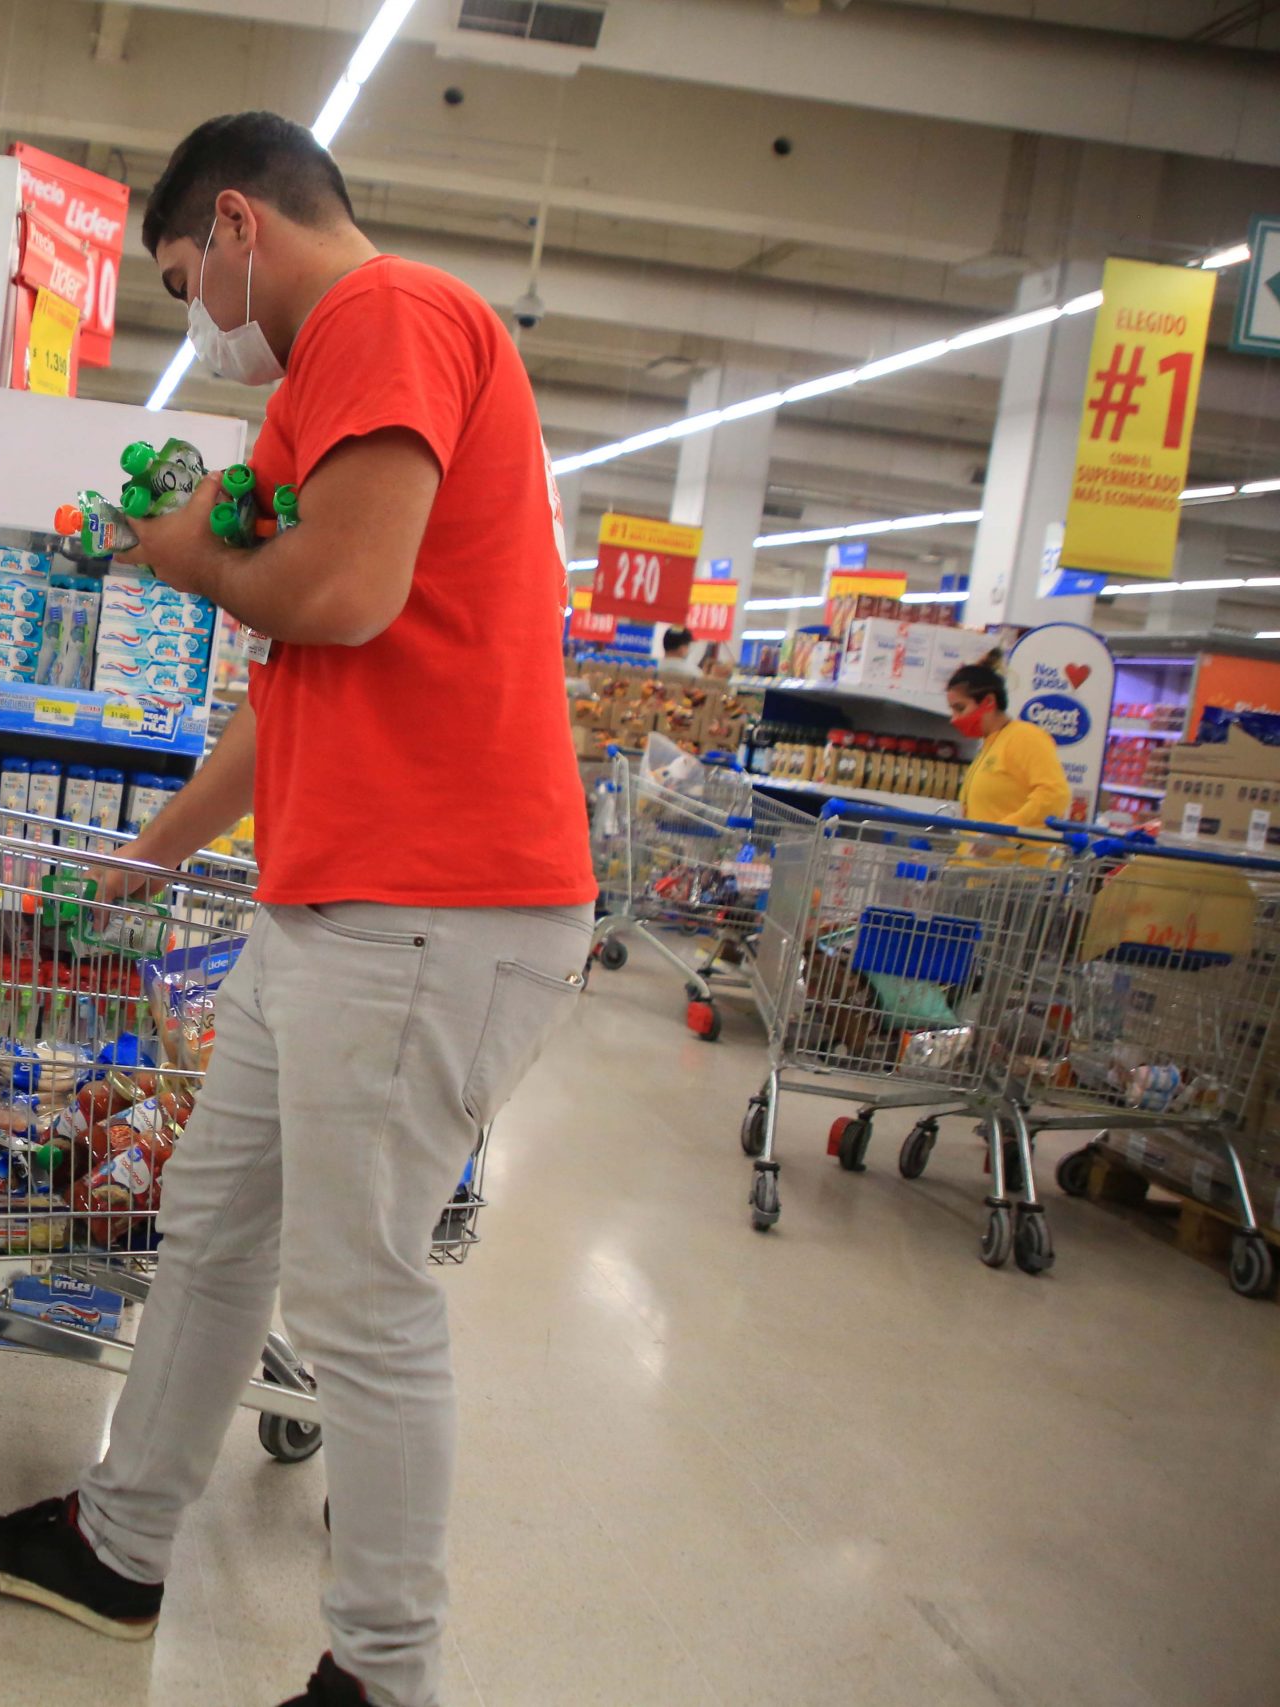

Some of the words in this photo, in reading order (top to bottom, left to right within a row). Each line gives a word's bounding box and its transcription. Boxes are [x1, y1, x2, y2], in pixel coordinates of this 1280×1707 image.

[19, 167, 66, 206] Precio
[64, 198, 121, 241] Lider
[29, 222, 57, 257] Precio
[49, 257, 82, 298] Lider
[1116, 308, 1187, 338] ELEGIDO
[1087, 342, 1194, 450] #1
[1077, 464, 1182, 494] SUPERMERCADO
[613, 551, 661, 605] 270
[1034, 663, 1059, 678] Nos
[1028, 702, 1081, 723] Great
